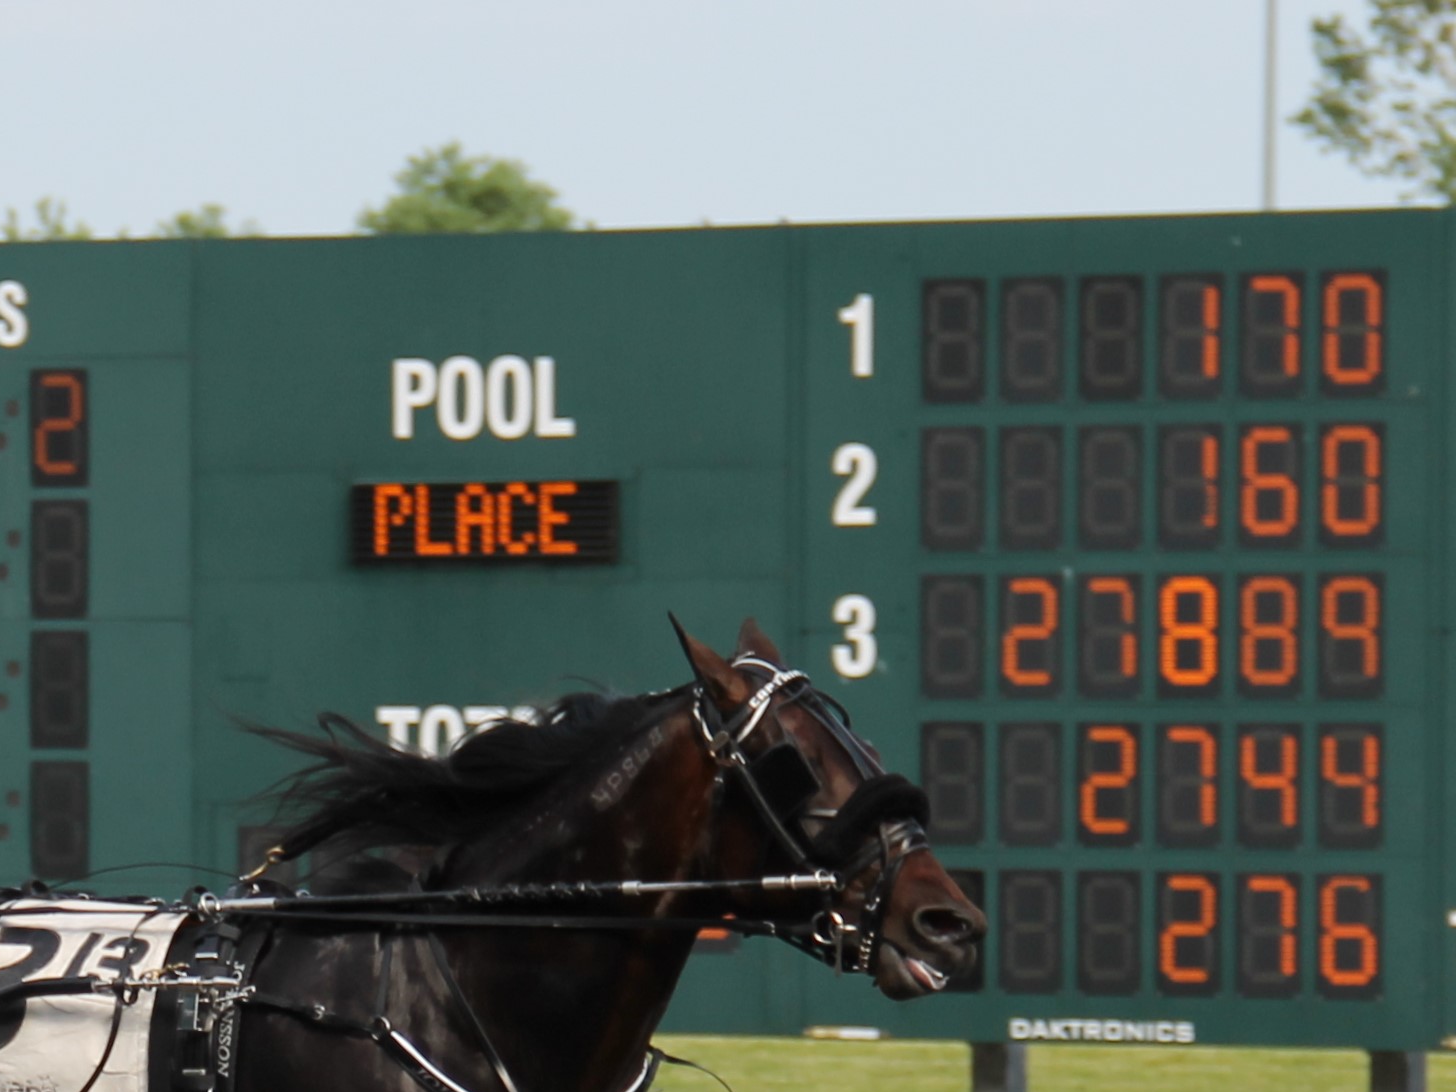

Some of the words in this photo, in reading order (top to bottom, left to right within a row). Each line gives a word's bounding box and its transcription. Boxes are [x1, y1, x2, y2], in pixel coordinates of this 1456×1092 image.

[838, 293, 874, 377] 1
[1202, 273, 1382, 385] 170
[392, 355, 576, 439] POOL
[373, 481, 578, 556] PLACE
[832, 443, 877, 526] 2
[1201, 425, 1382, 537] 160
[832, 594, 877, 678] 3
[1079, 725, 1380, 836] 2744
[1159, 874, 1379, 987] 276
[217, 960, 246, 1078] JONSSON
[1009, 1018, 1195, 1043] DAKTRONICS
